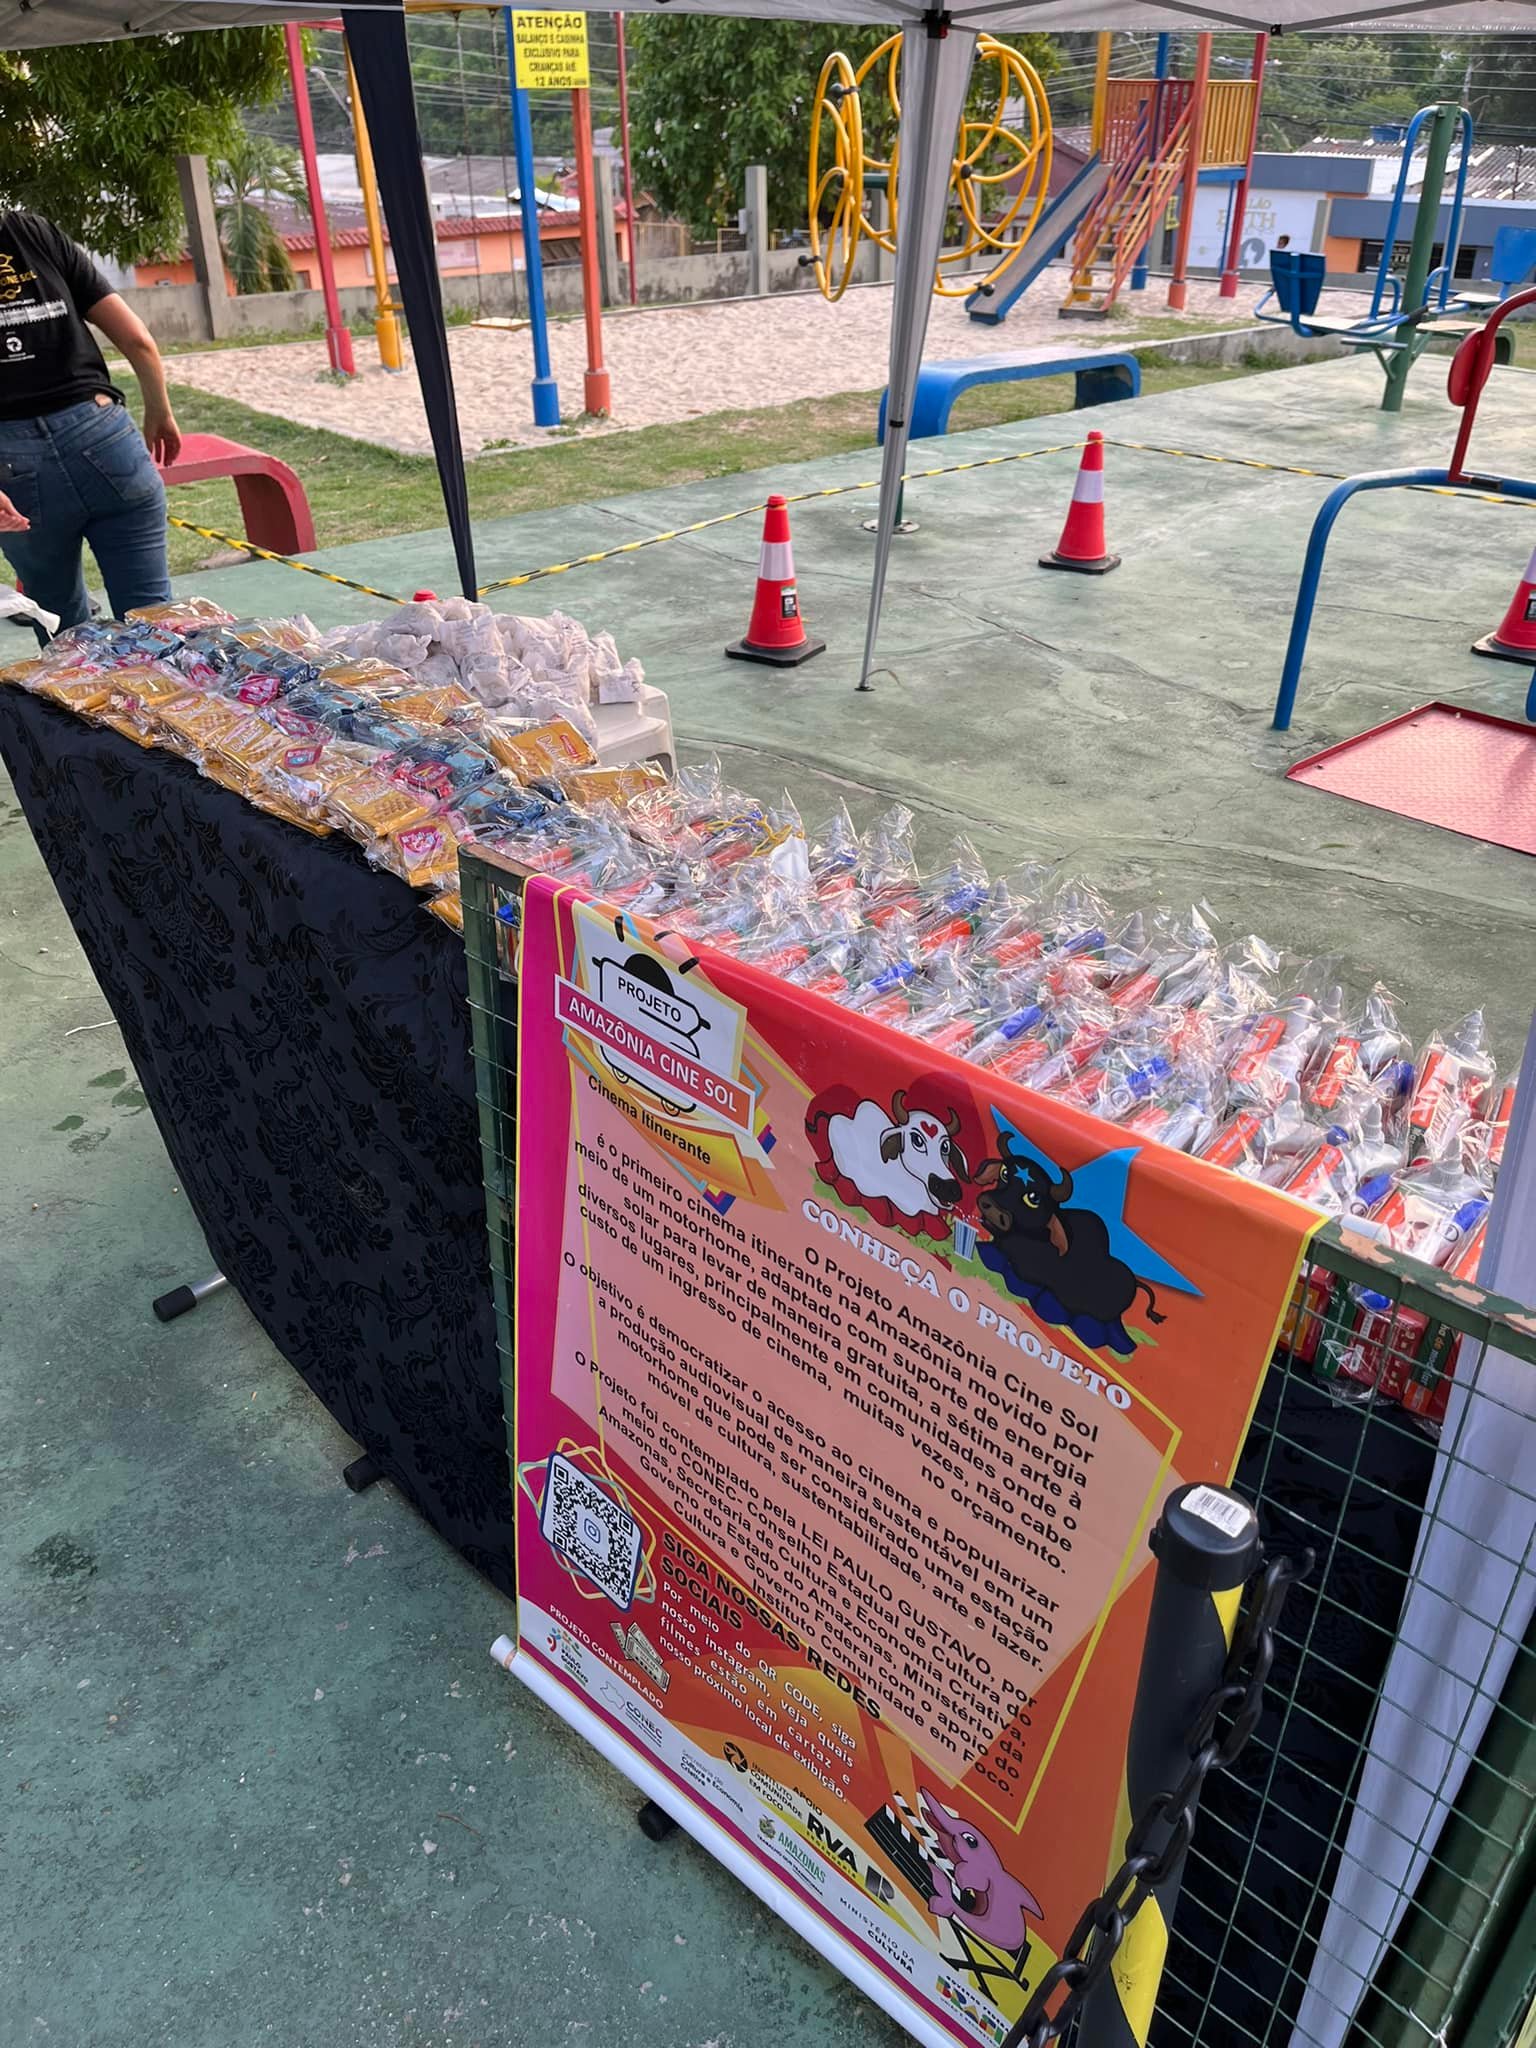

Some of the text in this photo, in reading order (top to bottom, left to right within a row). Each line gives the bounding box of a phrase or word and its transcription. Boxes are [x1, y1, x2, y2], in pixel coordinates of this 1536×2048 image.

[517, 14, 582, 31] ATENÇÃO
[524, 48, 580, 58] EXCLUSIVO PARA
[529, 62, 563, 73] CRIANÇAS
[535, 77, 545, 86] 12
[548, 76, 572, 86] ANOS
[618, 976, 682, 1023] PROJETO
[569, 997, 737, 1113] AMAZÔNIA CINE SOL
[588, 1074, 711, 1165] Cinema Itinerante
[574, 1140, 1087, 1488] meio de um motorhome, adaptado com suporte de energia
[597, 1133, 1095, 1464] é o primeiro cinema itinerante na Amazônia movido por
[802, 1200, 1132, 1410] CONHEÇA O PROJETO
[805, 1246, 1099, 1443] O Projeto Amazônia Cine Sol
[578, 1183, 1077, 1531] diversos lugares, principalmente em comunidades onde o
[563, 1251, 1060, 1613] O objetivo é democratizar o acesso ao cinema e popularizar
[575, 1350, 1037, 1708] O Projeto foi contemplado pela LEI PAULO GUSTAVO, por
[618, 1330, 1049, 1652] motorhome que pode ser considerado uma estação
[648, 1371, 1043, 1673] móvel de cultura, sustentabilidade, arte e lazer.
[622, 1406, 1031, 1726] meio do CONEC- Conselho Estadual de Cultura do
[640, 1455, 1023, 1763] Governo do Estado do Amazonas, Ministério da
[661, 1556, 742, 1629] SOCIAIS
[550, 1604, 591, 1644] PROJETO
[591, 1641, 664, 1710] CONTEMPLADO
[663, 1532, 881, 1720] SIGA NOSSAS REDES
[663, 1581, 856, 1749] Por meio do QR CODE, siga
[626, 1701, 663, 1740] CONEC
[659, 1635, 692, 1667] nosso
[694, 1664, 743, 1709] próximo
[744, 1703, 773, 1736] local
[774, 1733, 791, 1751] de
[793, 1749, 847, 1803] exibição.
[660, 1616, 851, 1785] filmes estão em cartaz e
[661, 1600, 854, 1768] nosso instagram, veja quais
[765, 1593, 1014, 1797] Instituto Comunidade em Foco.
[749, 1778, 784, 1811] EM FOCO
[750, 1768, 803, 1820] COMUNIDADE
[752, 1762, 793, 1802] INSTITUTO
[792, 1786, 823, 1817] APOIO
[777, 1829, 828, 1886] AMAZONAS
[806, 1811, 859, 1874] RVA
[839, 1897, 915, 1965] MINISTÉRIO DA
[867, 1929, 913, 1974] CULTURA
[934, 1973, 1006, 2048] BRASI
[982, 2006, 1010, 2034] FEDERA
